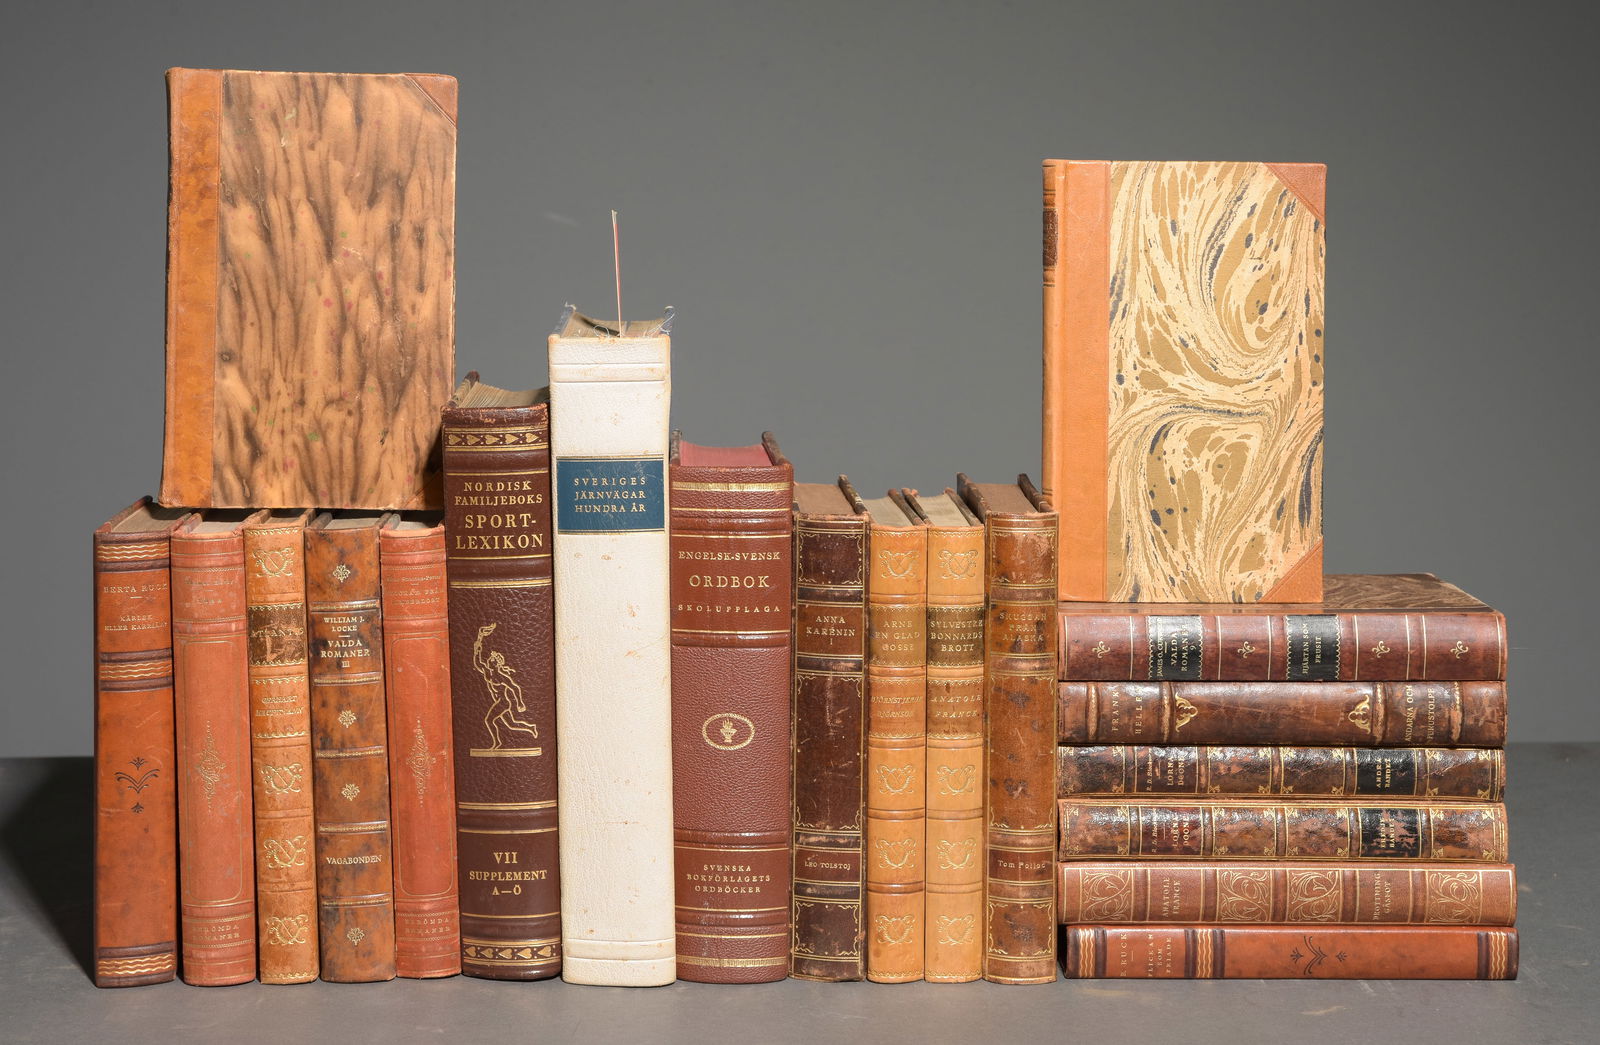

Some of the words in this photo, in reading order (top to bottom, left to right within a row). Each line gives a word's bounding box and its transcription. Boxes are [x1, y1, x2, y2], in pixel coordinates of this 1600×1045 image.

[464, 481, 532, 491] NORDISK
[574, 477, 646, 486] SVERIGES
[574, 490, 646, 500] JÄRNVÄGAR
[454, 494, 543, 506] FAMILJEBOKS
[575, 504, 626, 513] HUNDRA
[630, 502, 646, 512] ÅR
[465, 513, 536, 528] SPORT-
[455, 534, 543, 549] LEXIKON
[678, 551, 781, 560] ENGELSK-SVENSK
[689, 575, 769, 588] ORDBOK
[678, 604, 780, 613] SKOLUPPLAGA
[815, 615, 846, 624] ANNA
[806, 627, 856, 637] KARÉNIN
[874, 631, 888, 639] EN
[893, 631, 920, 640] GLAD
[327, 640, 362, 648] VALDA
[941, 643, 975, 652] BROTT
[320, 649, 371, 658] ROMANER
[931, 694, 982, 703] ANATOLE
[1405, 685, 1414, 703] OCH
[935, 710, 978, 718] FRANCE
[326, 855, 382, 865] VAGABONDEN
[493, 851, 518, 864] VII
[703, 864, 751, 872] SVENSKA
[820, 862, 851, 871] TOLSTOJ
[997, 860, 1015, 868] Tom
[469, 870, 547, 881] SUPPLEMENT
[686, 873, 771, 882] BOKFÖRLAGETS
[694, 885, 761, 893] ORDBÖCKER
